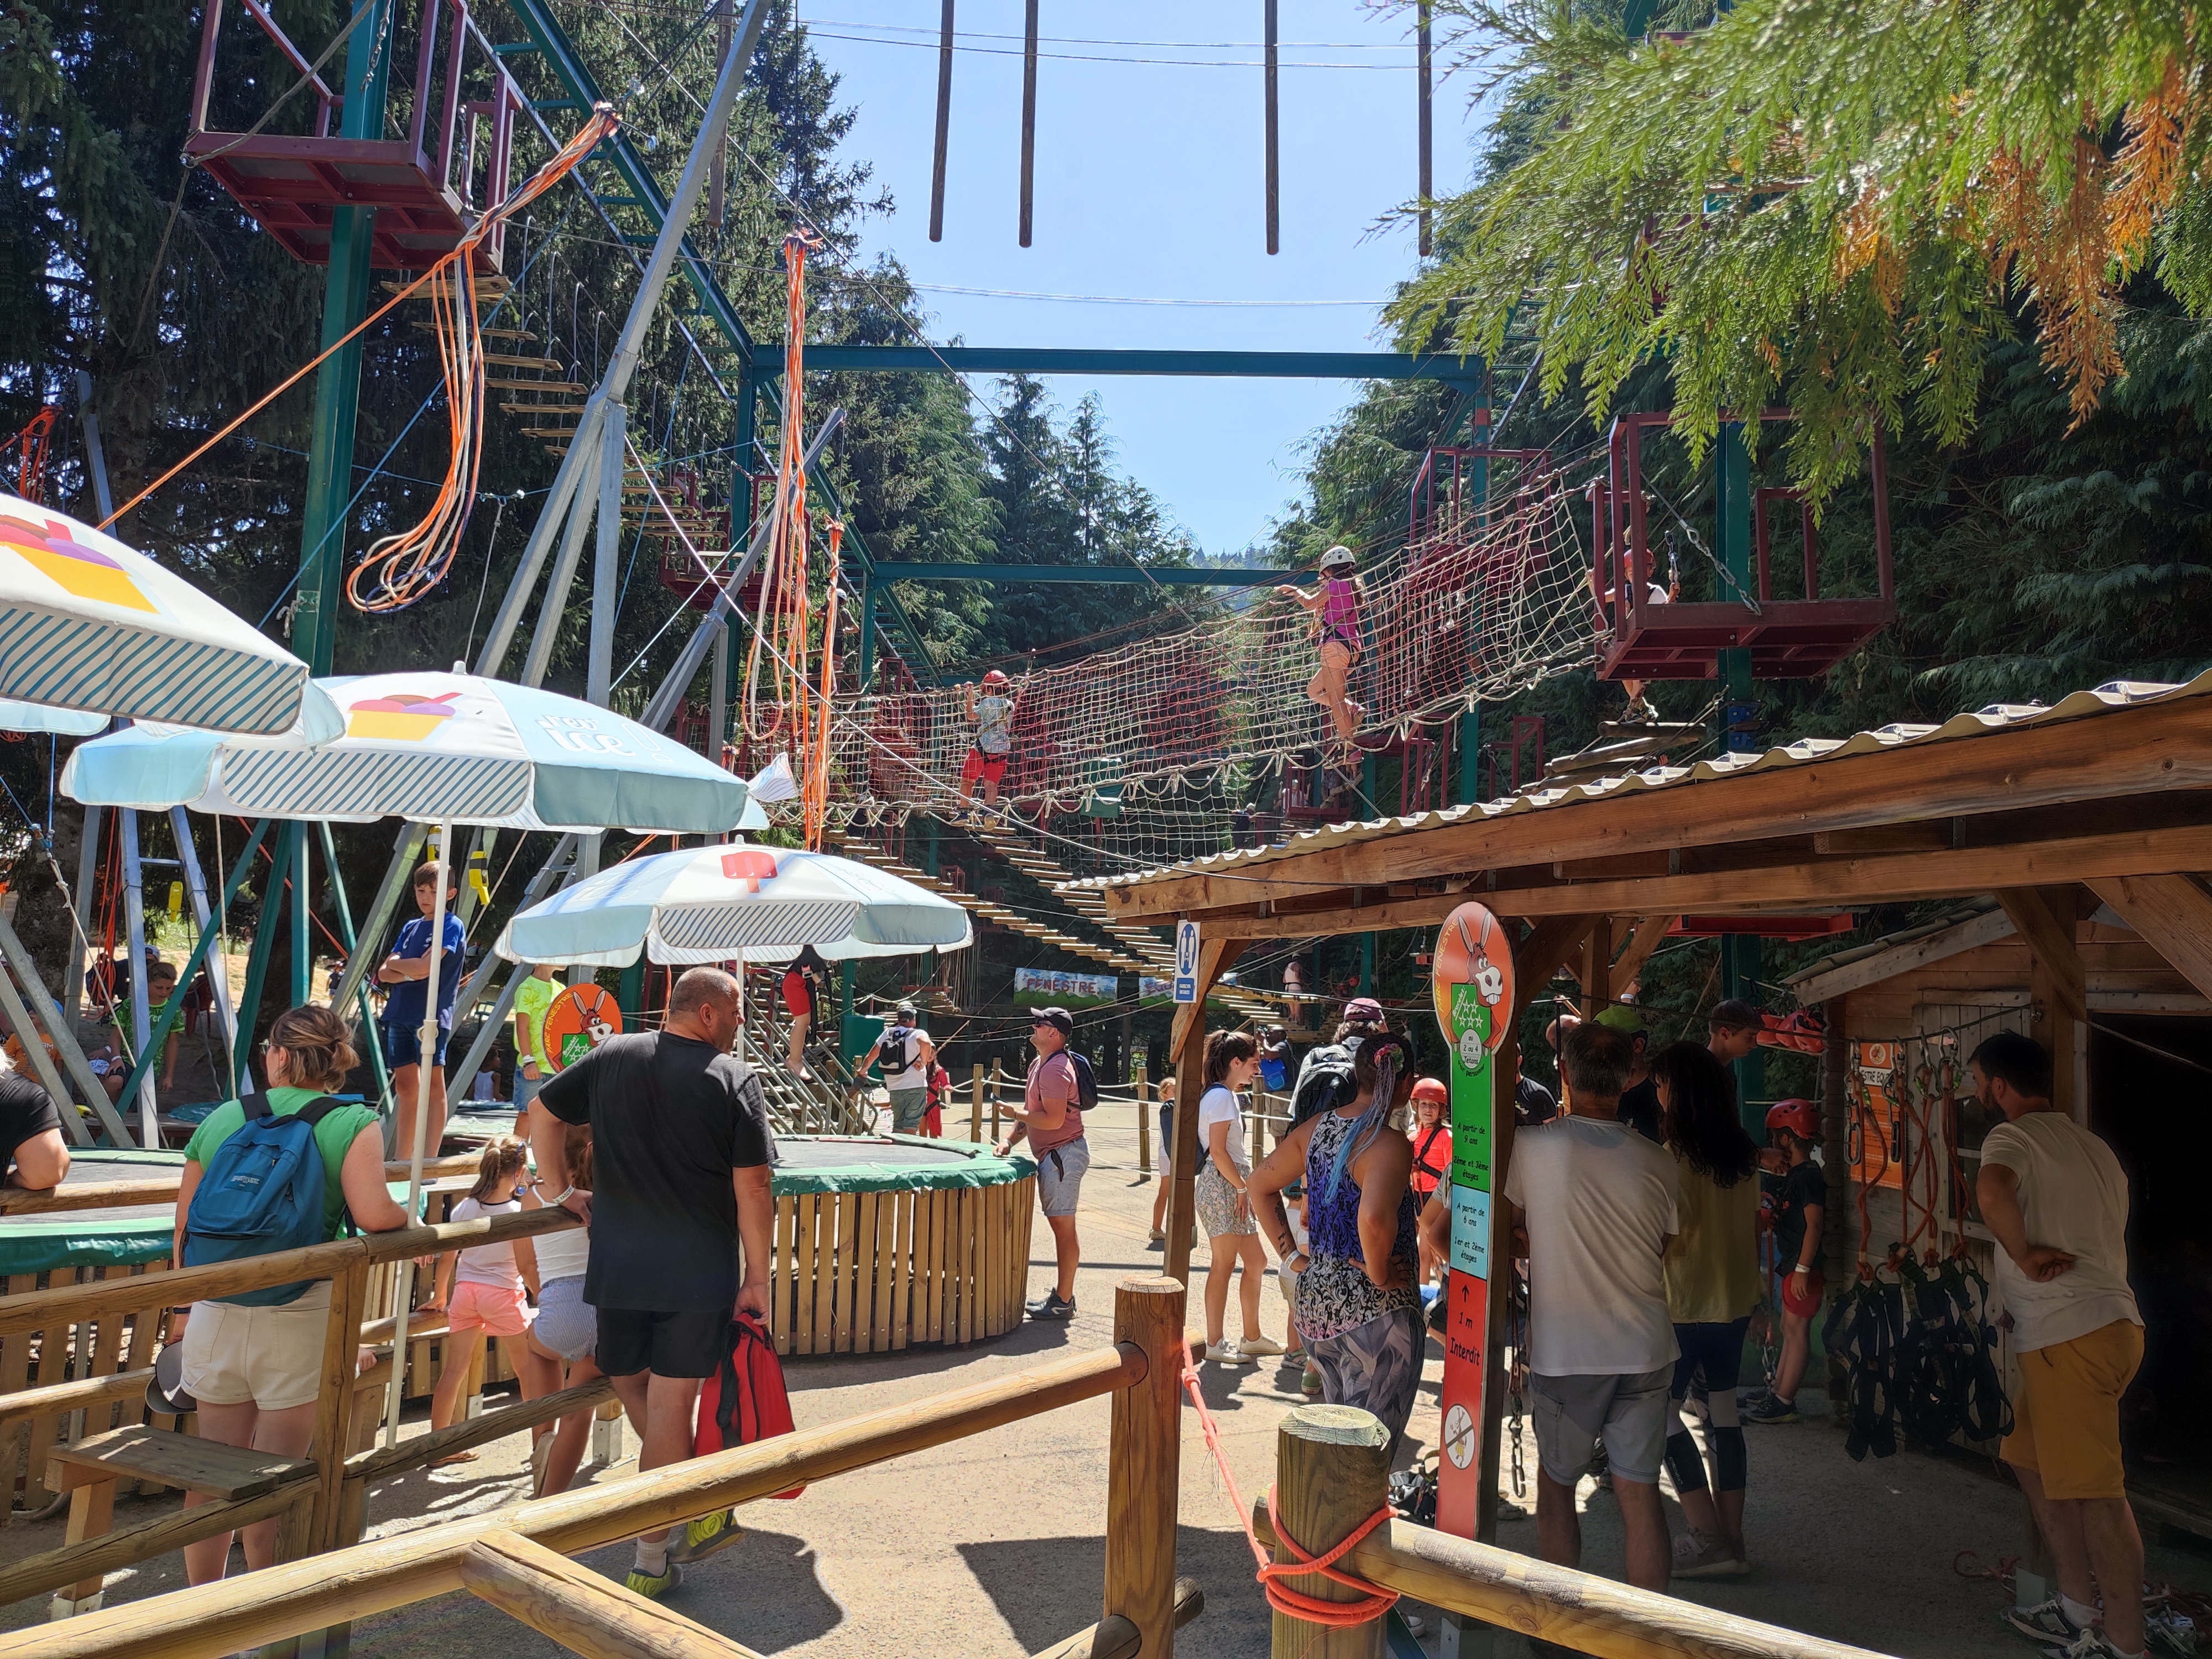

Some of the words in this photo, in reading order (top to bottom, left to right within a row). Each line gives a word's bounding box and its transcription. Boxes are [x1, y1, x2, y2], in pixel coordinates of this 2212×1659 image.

[1436, 919, 1458, 977] FENESTRE
[1026, 978, 1098, 994] FENESTRE
[1436, 981, 1444, 1013] PARC
[546, 993, 573, 1031] FENESTRE
[545, 1032, 554, 1053] PARC
[1463, 1056, 1479, 1065] Jetons
[1457, 1121, 1461, 1130] A
[1463, 1124, 1478, 1133] partir
[1479, 1126, 1485, 1134] de
[1463, 1134, 1468, 1142] 9
[1454, 1155, 1466, 1166] 2ème
[1475, 1160, 1489, 1171] 3ème
[1462, 1168, 1479, 1182] étages
[1457, 1202, 1460, 1210] A
[1462, 1204, 1477, 1214] partir
[1478, 1207, 1485, 1217] de
[1463, 1215, 1467, 1223] 6
[1454, 1235, 1463, 1246] 1er
[1472, 1241, 1485, 1254] 2ème
[1460, 1250, 1477, 1264] étages
[1459, 1311, 1463, 1324] 1
[1465, 1318, 1473, 1329] m
[1449, 1337, 1480, 1366] Interdit
